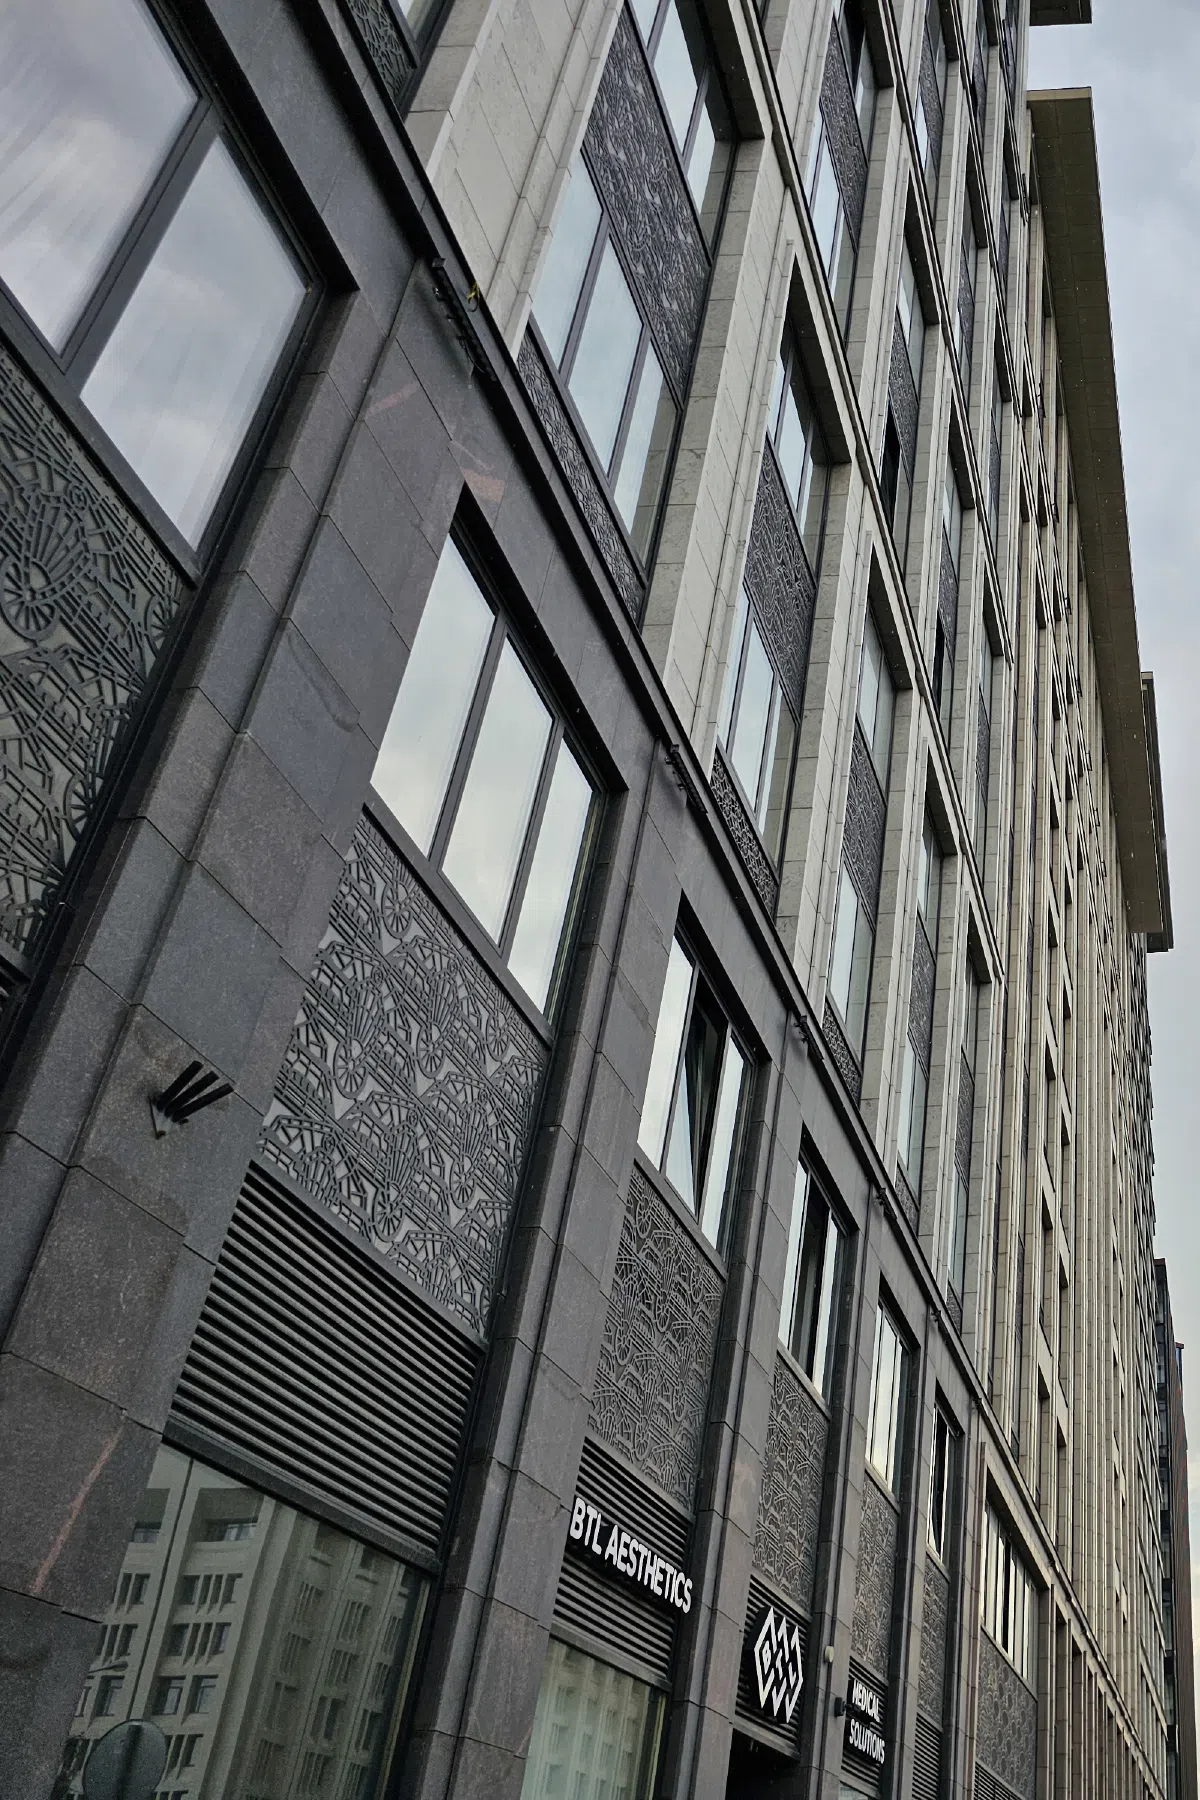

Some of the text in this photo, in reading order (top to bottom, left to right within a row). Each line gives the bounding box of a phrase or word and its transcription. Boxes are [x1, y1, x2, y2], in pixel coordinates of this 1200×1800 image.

[569, 1497, 693, 1614] BTL AESTHETICS
[852, 1679, 881, 1723] MEDICAL
[849, 1718, 886, 1764] SOLUTIONS
